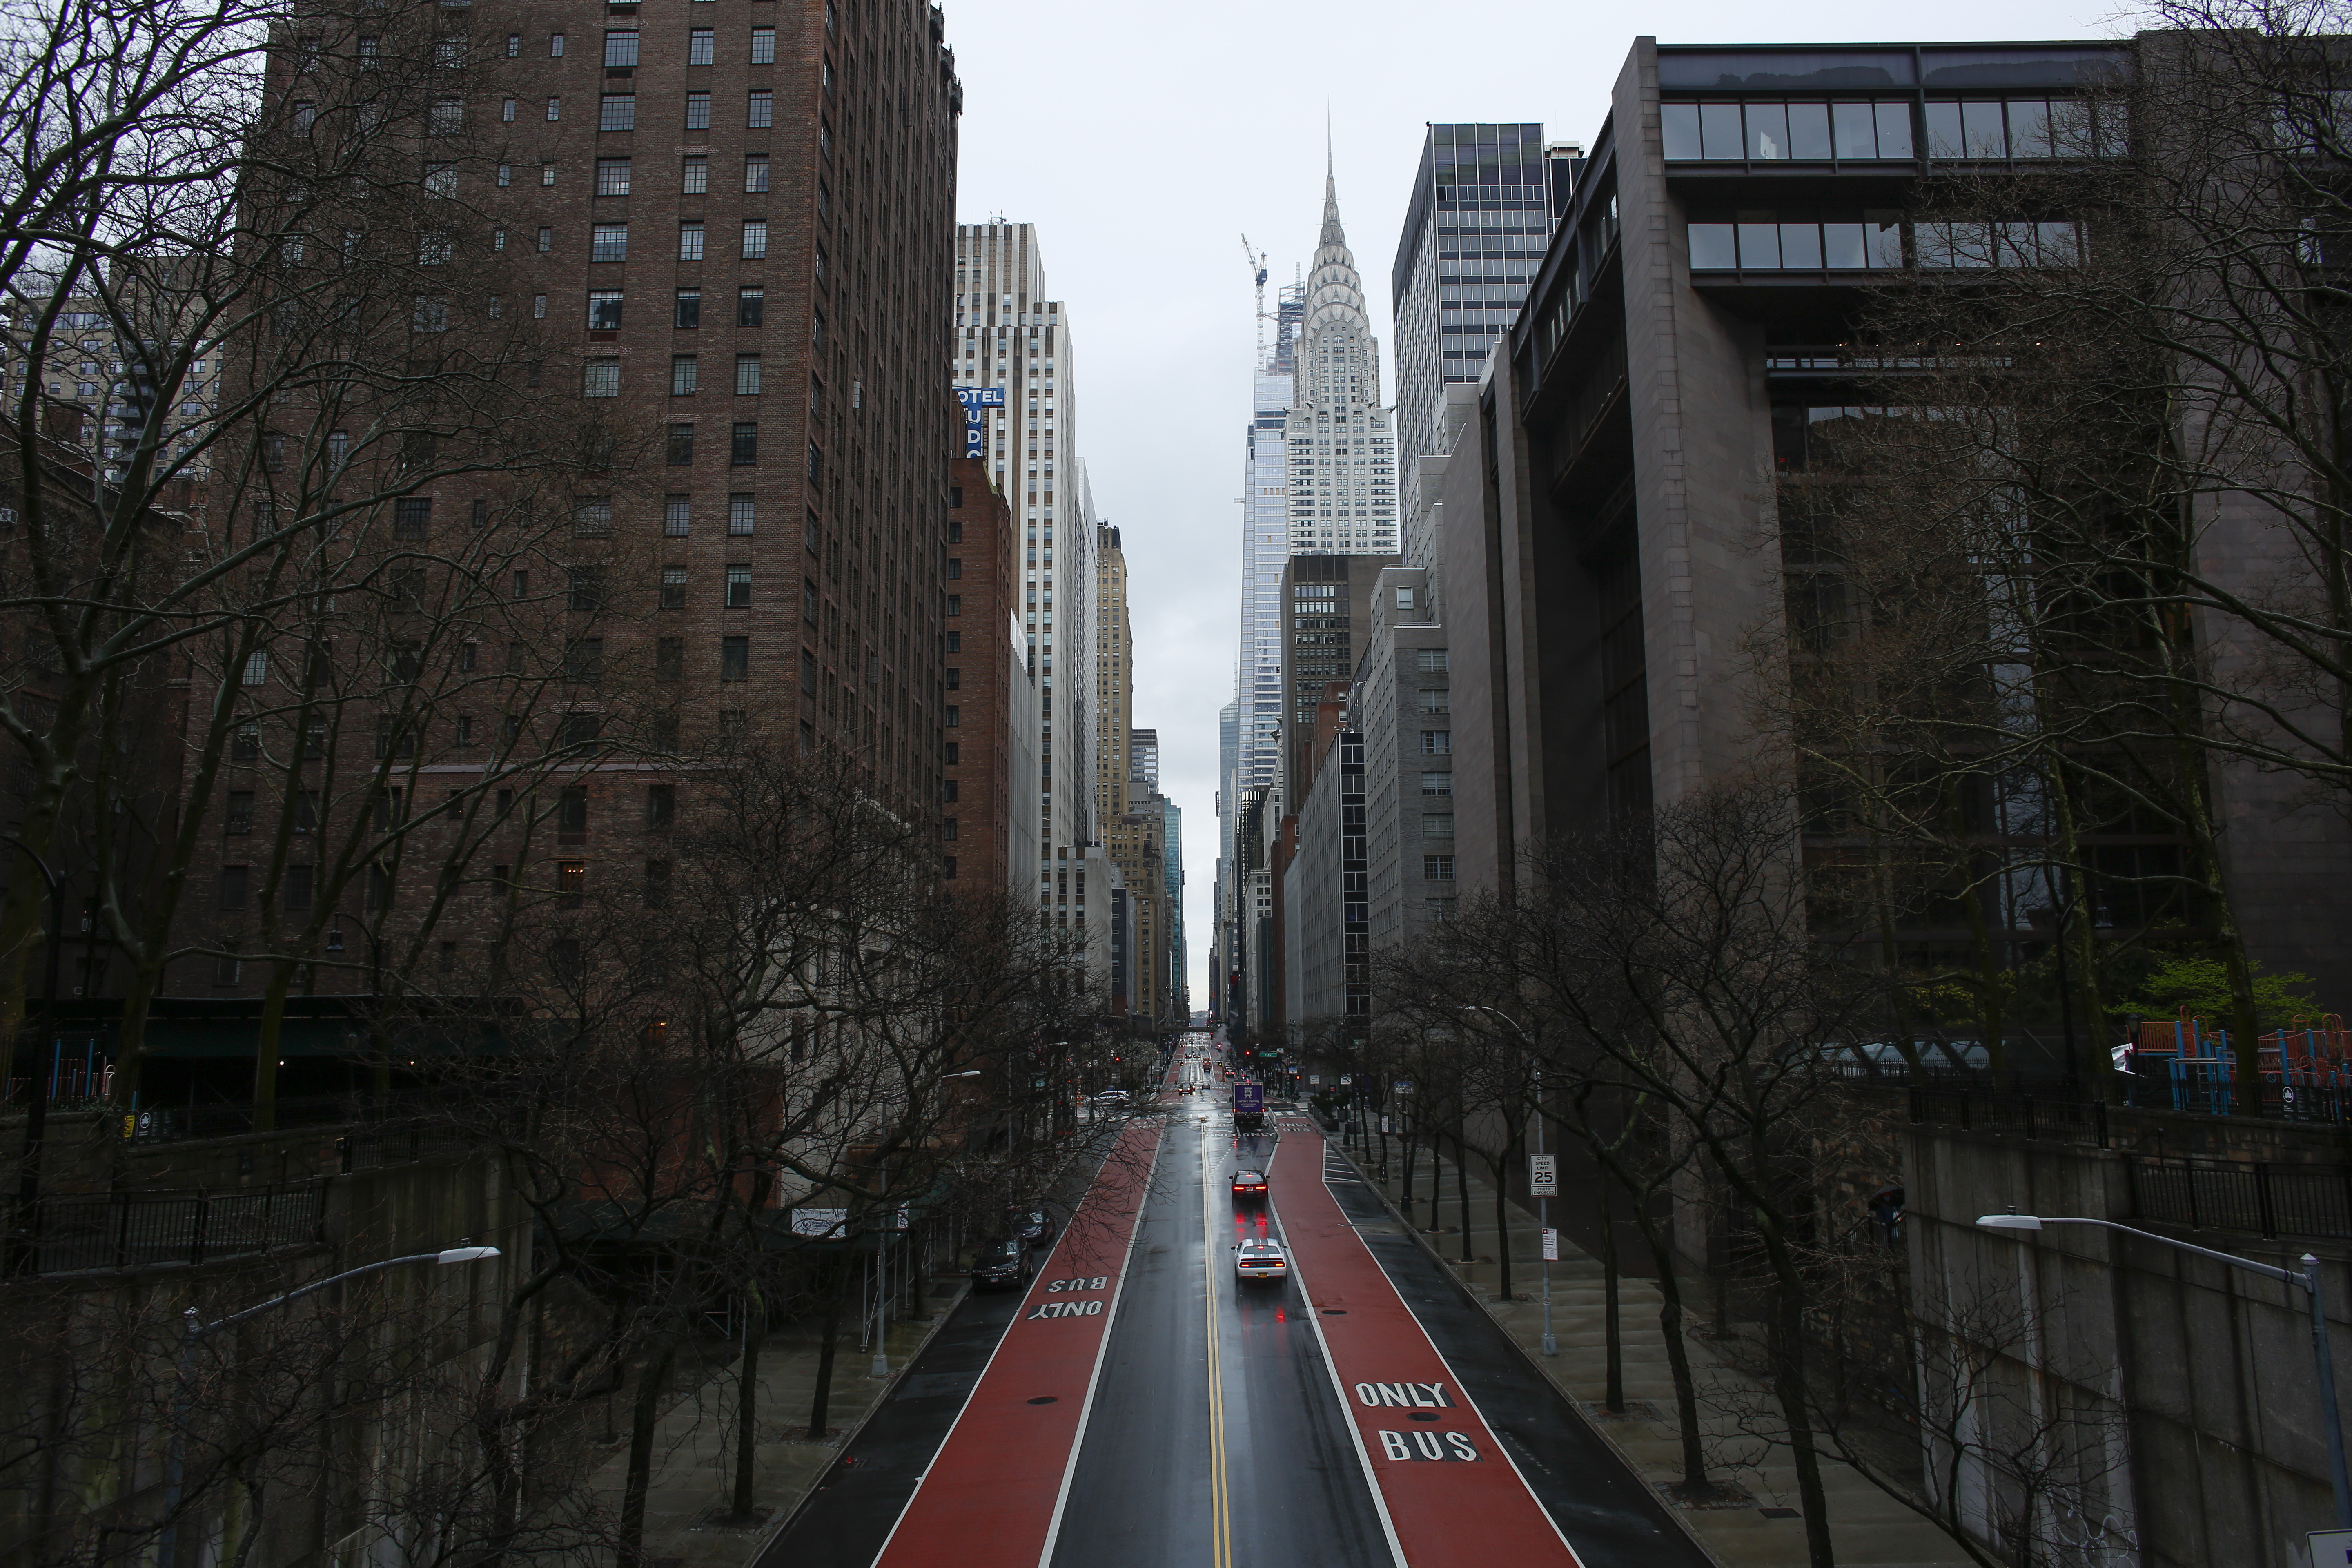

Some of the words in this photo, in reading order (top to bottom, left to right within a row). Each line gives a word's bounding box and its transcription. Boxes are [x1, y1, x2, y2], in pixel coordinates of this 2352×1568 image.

[958, 390, 1003, 403] OTEL
[967, 390, 981, 458] TUDO
[1535, 1172, 1552, 1183] 25
[1048, 1276, 1108, 1292] BUS
[1026, 1301, 1102, 1320] ONLY
[1354, 1383, 1447, 1407] ONLY
[1378, 1430, 1477, 1461] BUS
